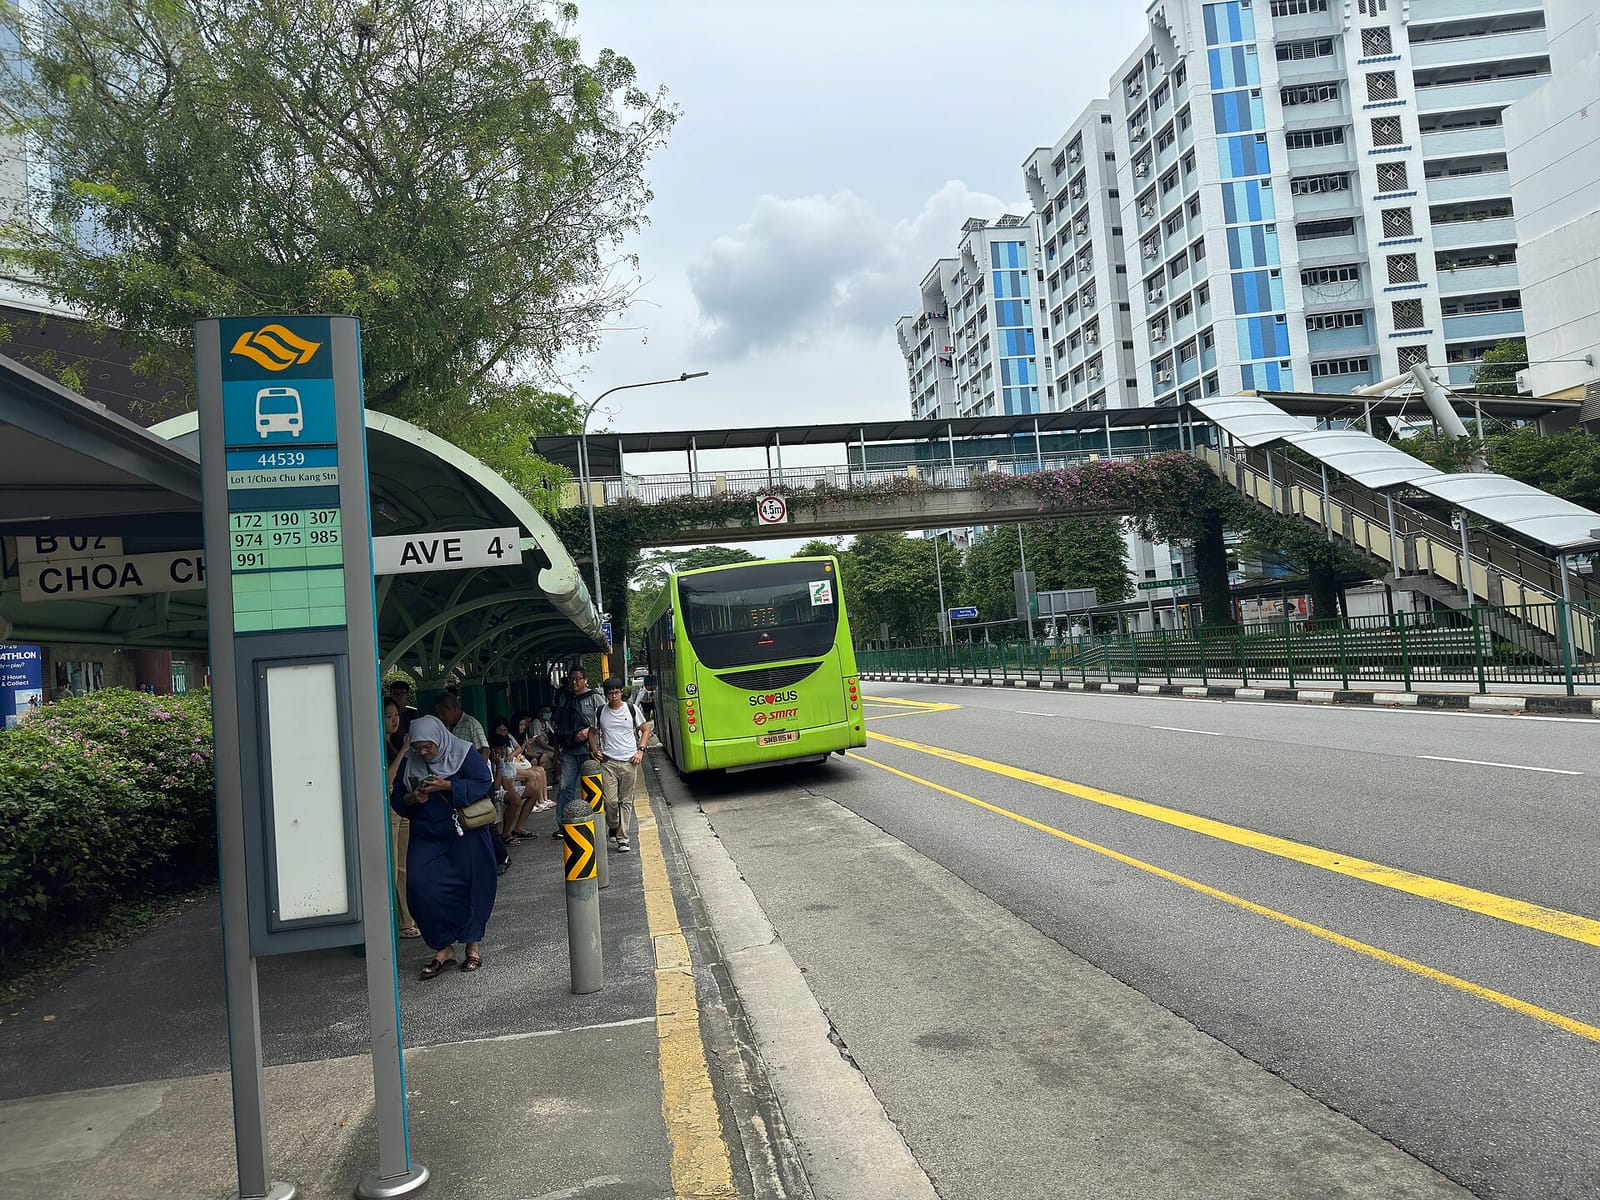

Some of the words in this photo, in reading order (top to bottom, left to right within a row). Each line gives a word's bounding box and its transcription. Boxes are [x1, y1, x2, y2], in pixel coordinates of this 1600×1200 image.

[257, 452, 305, 467] 44539
[230, 475, 244, 485] Lot
[247, 474, 277, 484] 1/Choa
[279, 473, 296, 483] Chu
[298, 473, 321, 483] Kang
[322, 472, 337, 481] Stn
[762, 504, 782, 516] 4.5m
[234, 514, 263, 528] 172
[271, 512, 299, 527] 190
[309, 510, 337, 525] 307
[235, 533, 264, 548] 974
[272, 531, 302, 546] 975
[310, 530, 338, 544] 985
[38, 562, 143, 594] CHOA
[400, 538, 463, 567] AVE
[487, 536, 504, 559] 4
[236, 552, 264, 567] 991
[748, 694, 766, 707] SG
[774, 690, 798, 703] BUS
[768, 707, 800, 720] SMRT
